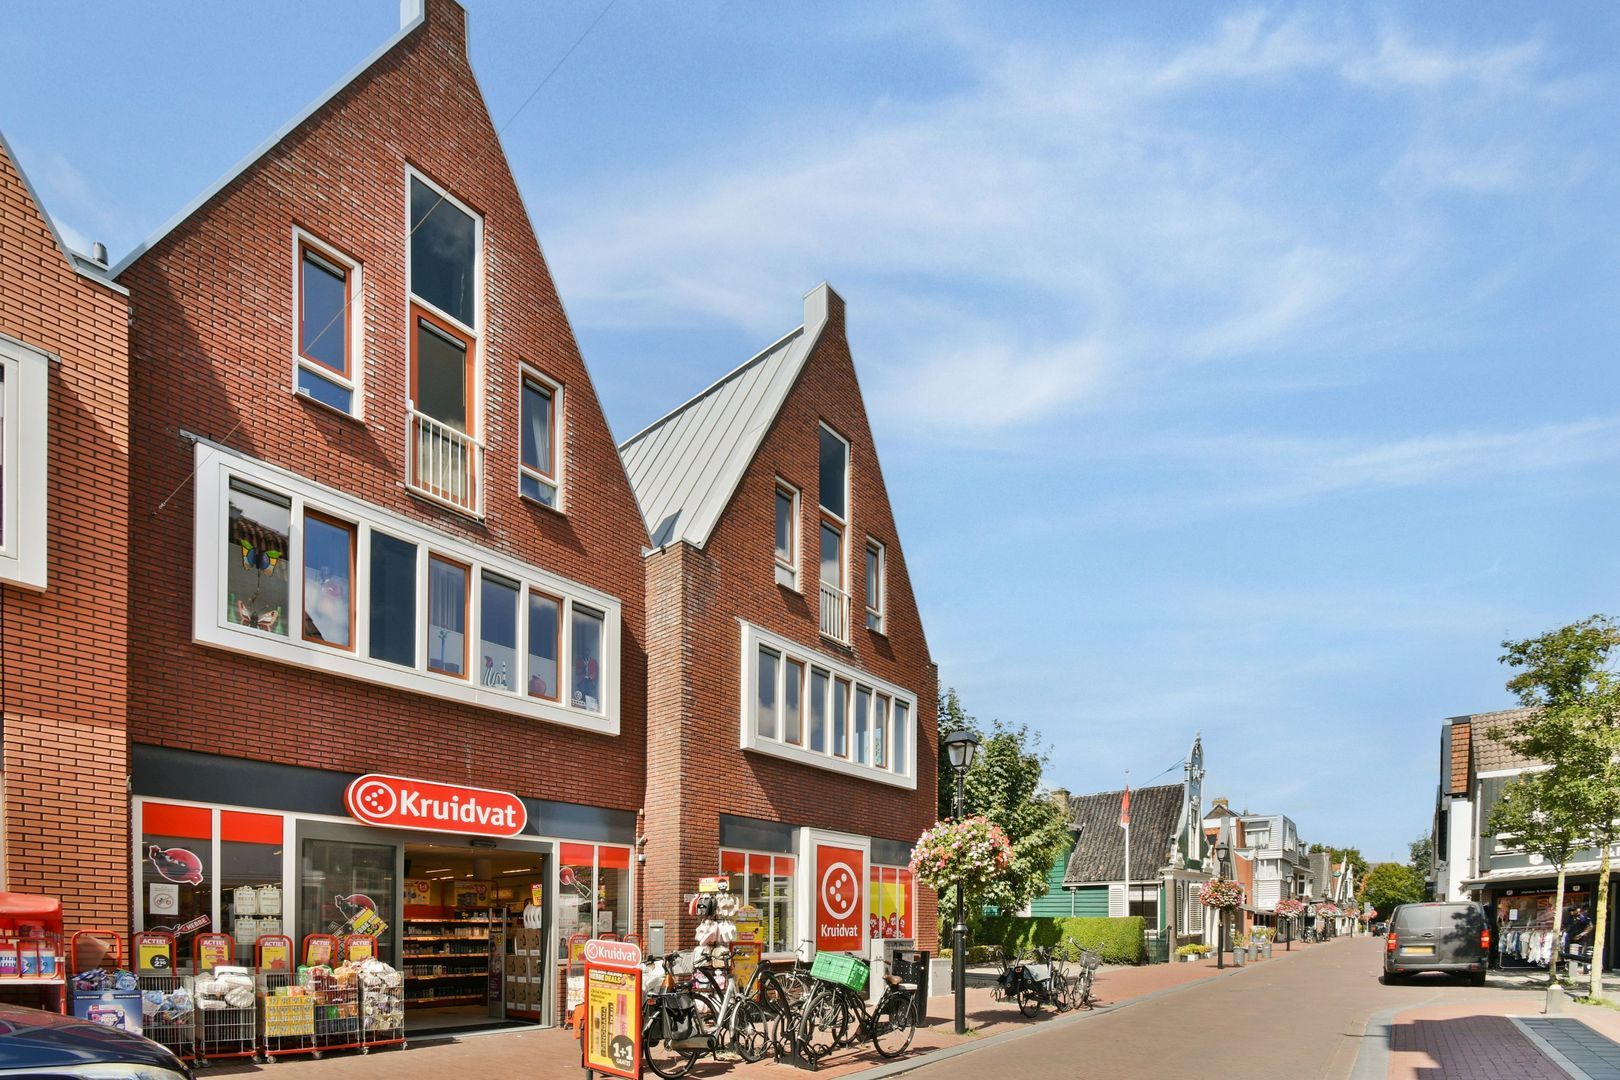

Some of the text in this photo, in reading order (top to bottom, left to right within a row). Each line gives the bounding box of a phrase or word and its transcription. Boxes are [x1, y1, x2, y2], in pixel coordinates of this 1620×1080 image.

[401, 789, 517, 828] Kruidvat
[821, 924, 858, 937] Kruidvat
[598, 945, 637, 963] Kruidvat
[613, 1042, 633, 1061] 1+1
